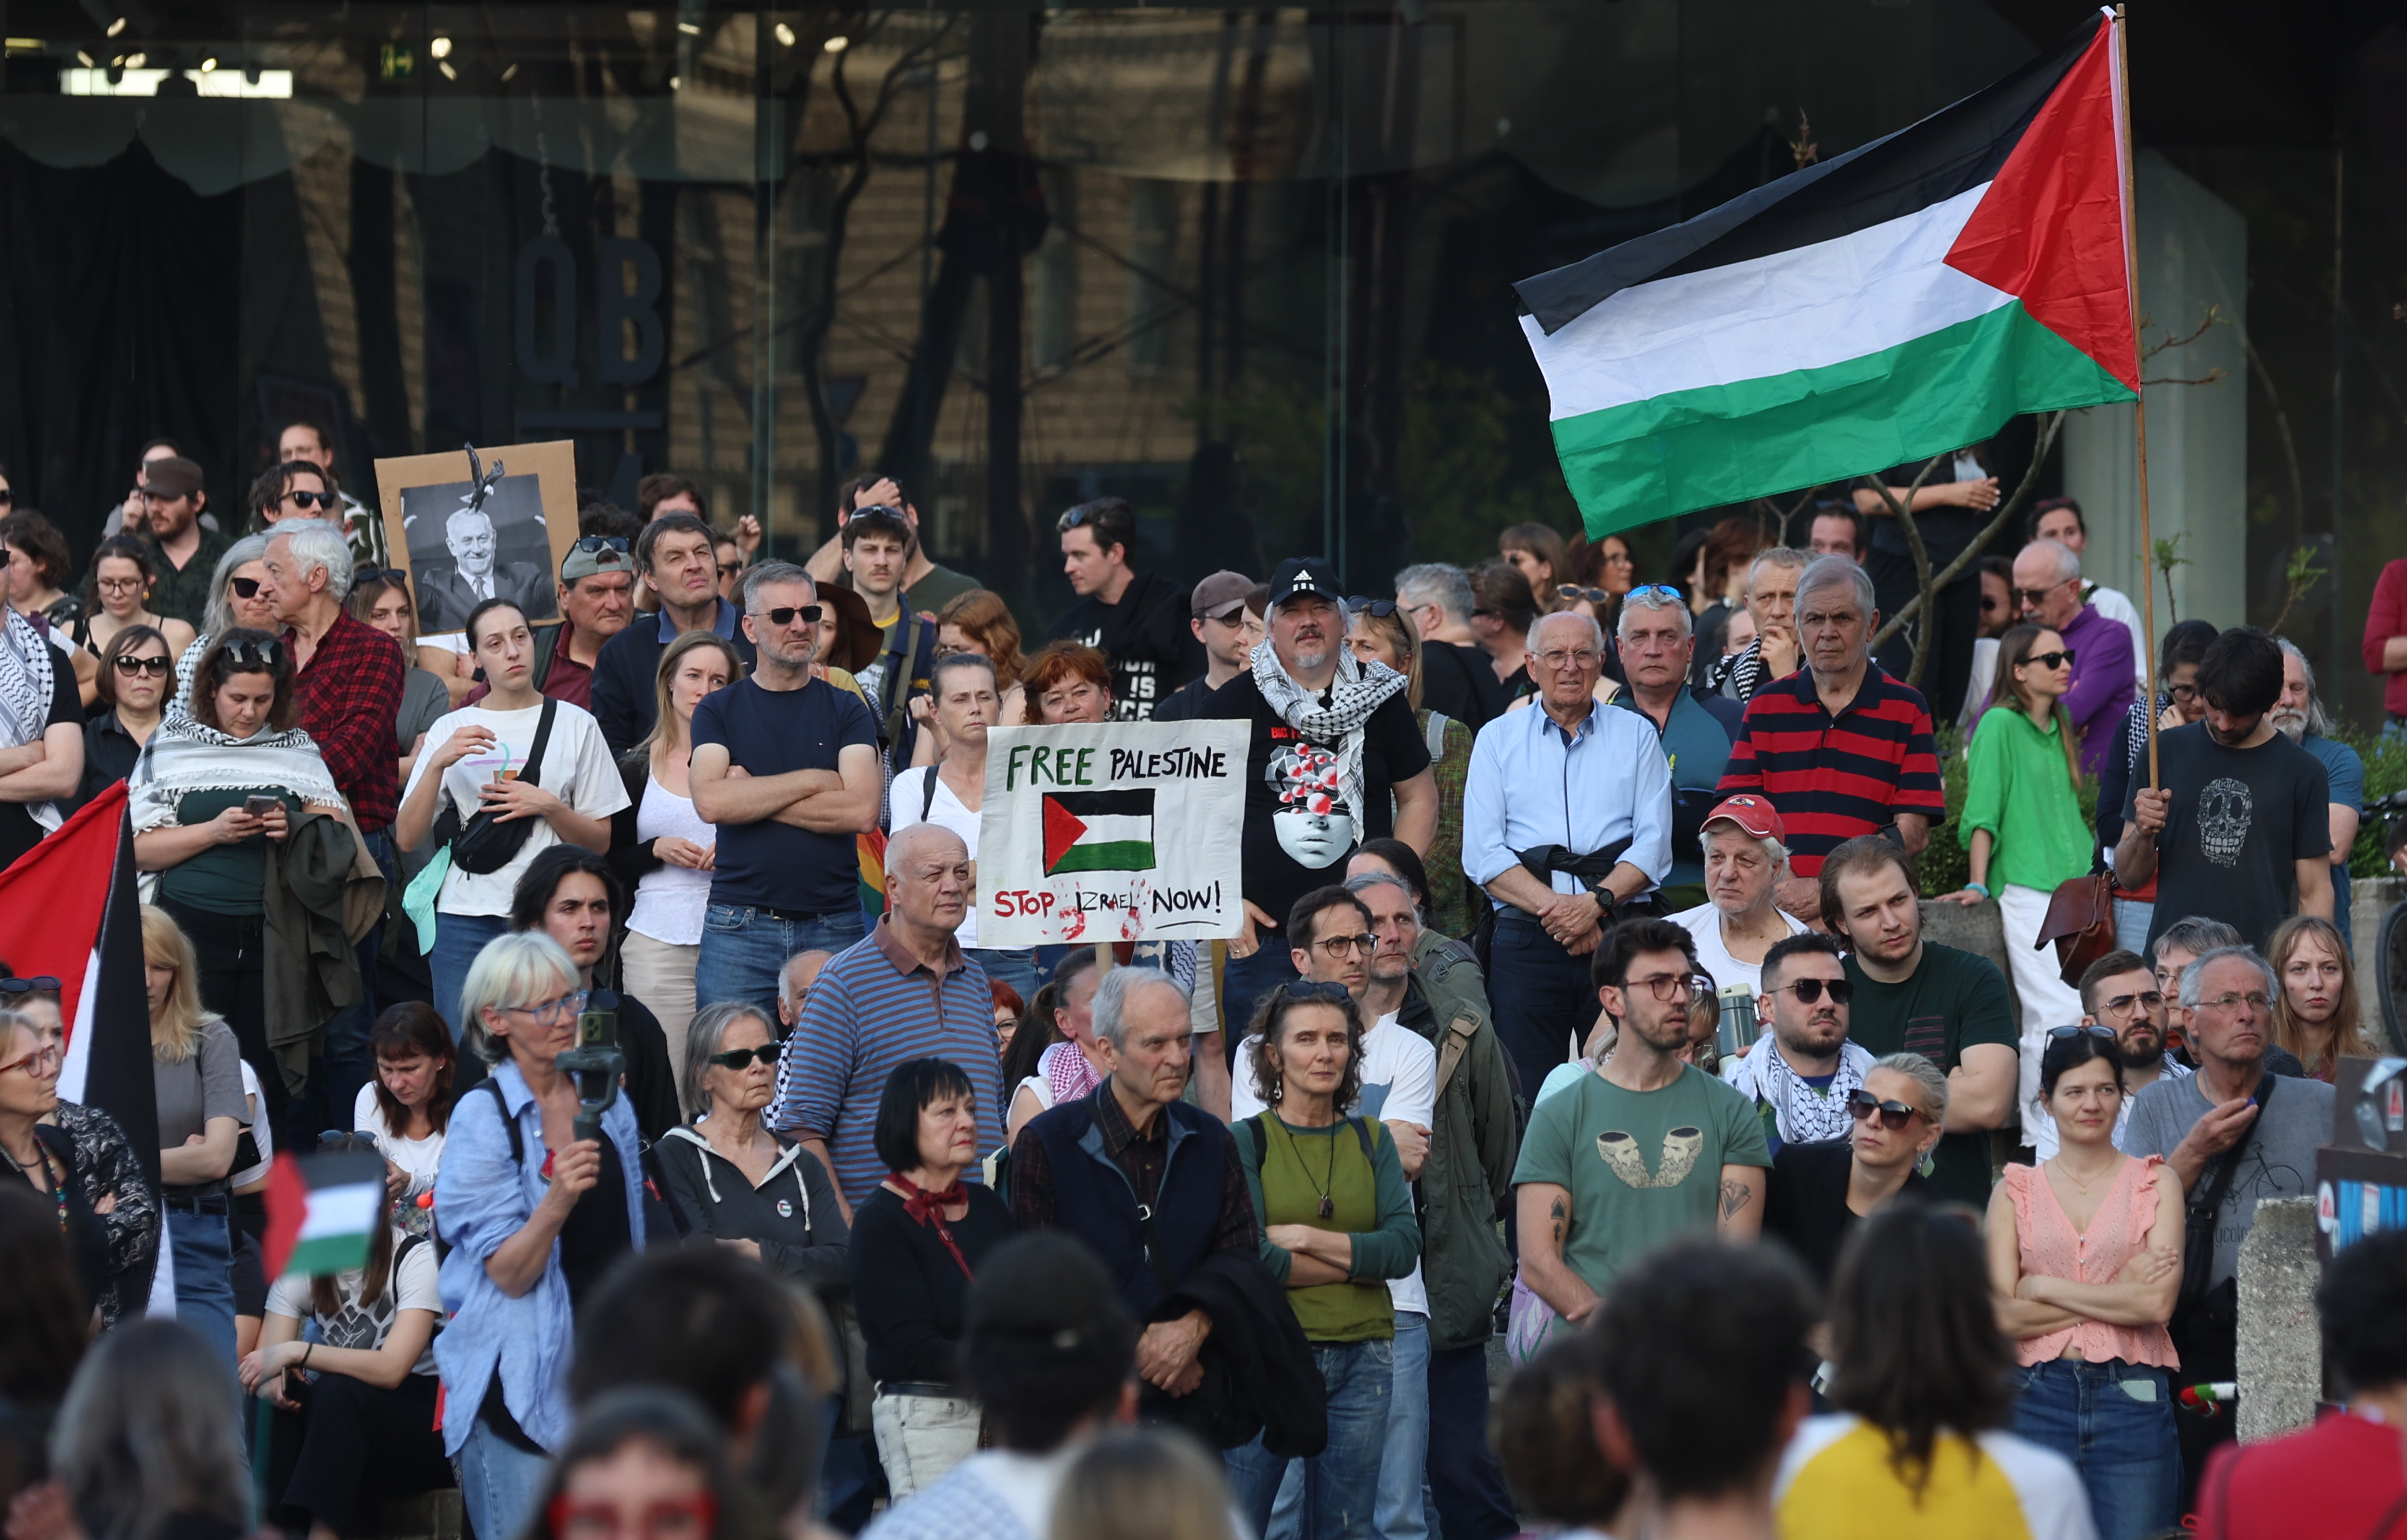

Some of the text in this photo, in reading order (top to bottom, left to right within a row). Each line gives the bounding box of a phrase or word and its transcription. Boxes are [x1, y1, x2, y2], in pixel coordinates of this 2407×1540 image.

[515, 235, 664, 389] QB
[1129, 675, 1156, 699] IS
[1270, 726, 1289, 739] BIG
[1006, 745, 1228, 792] FREE PALESTINE
[994, 880, 1222, 918] STOP IZRAEL NOW!
